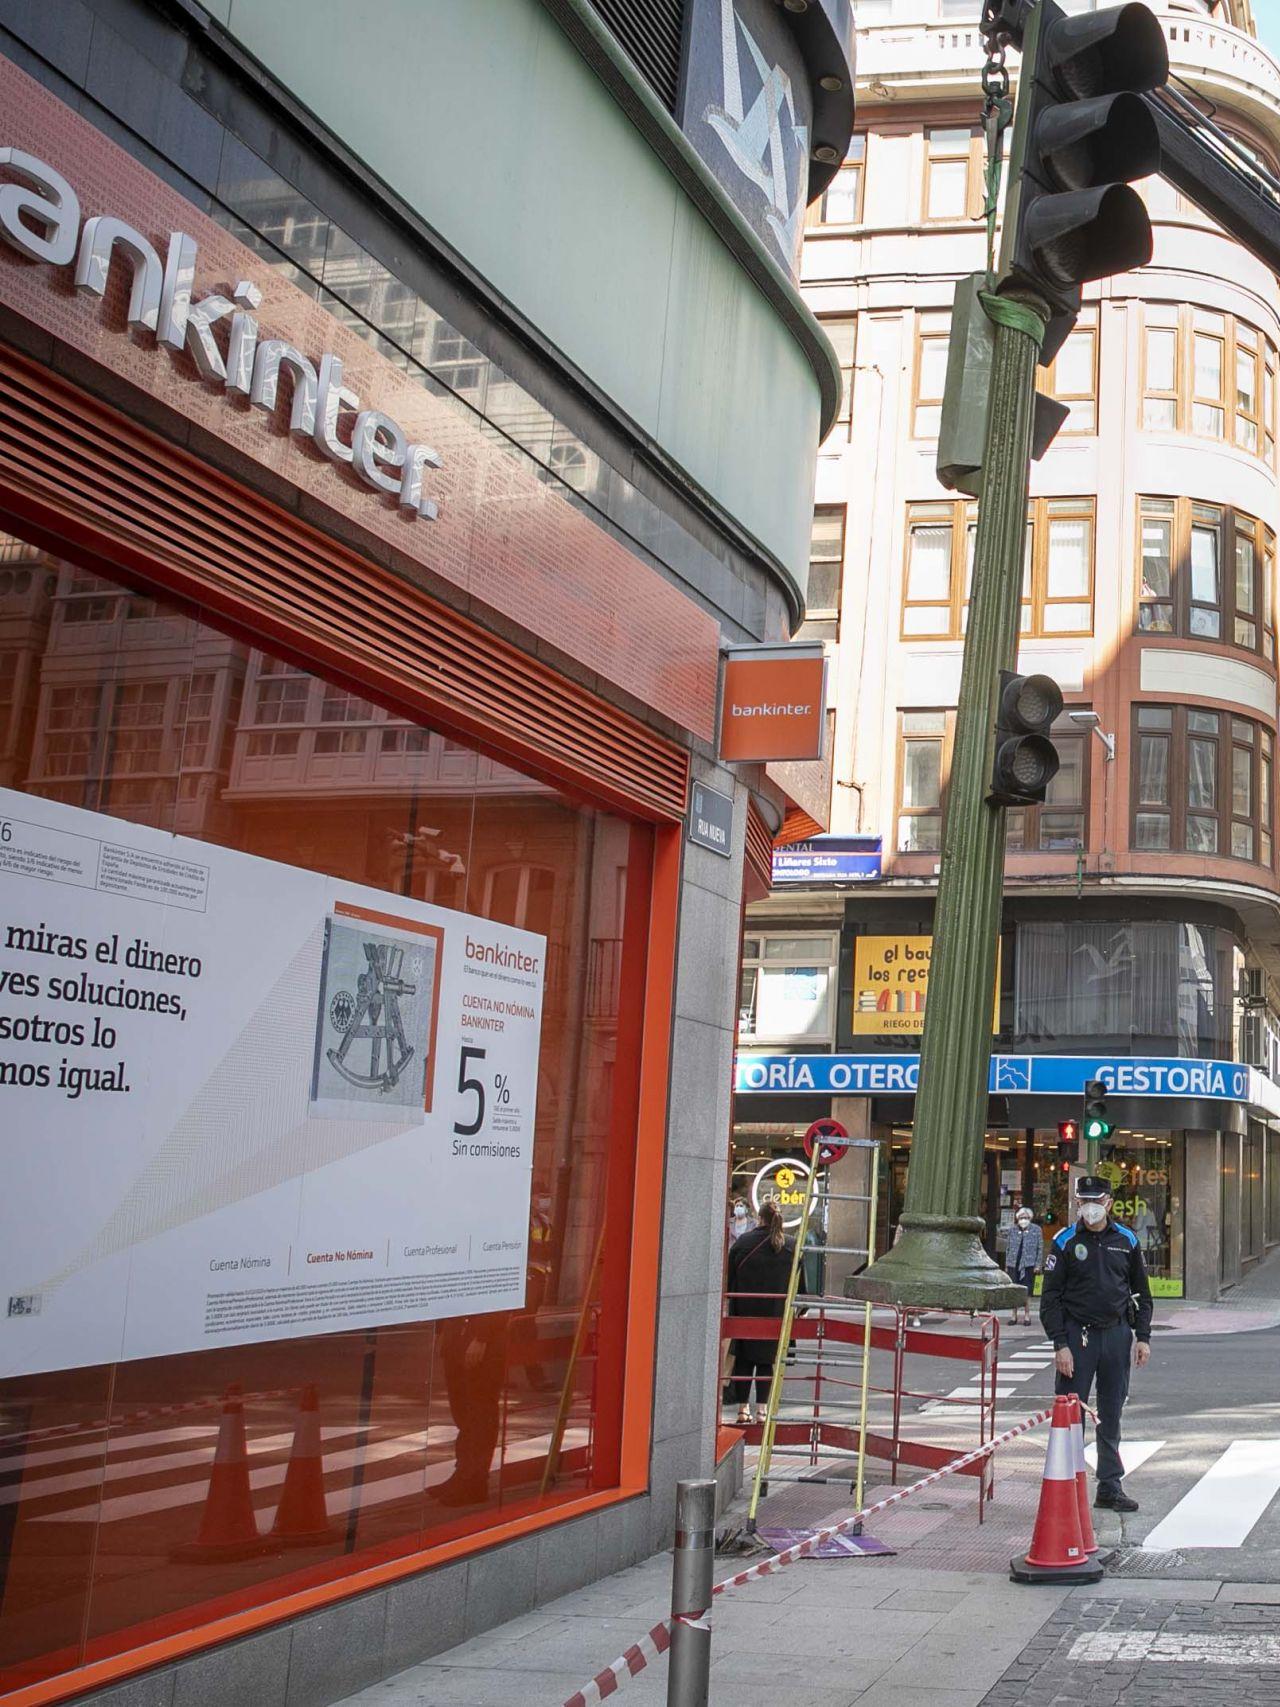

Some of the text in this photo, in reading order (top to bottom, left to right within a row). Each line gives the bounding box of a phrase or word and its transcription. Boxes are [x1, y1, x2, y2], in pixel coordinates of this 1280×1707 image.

[813, 856, 838, 867] Sixto
[5, 923, 201, 978] miras el dinero
[465, 936, 539, 974] bankinter.
[884, 944, 898, 964] el
[868, 965, 890, 982] los
[47, 972, 187, 1021] soluciones,
[462, 994, 535, 1020] CUENTA NO NÓMINA
[91, 1017, 116, 1049] lo
[461, 1014, 505, 1033] BANKINTER
[883, 1019, 911, 1028] RIEGO
[57, 1058, 130, 1099] igual.
[454, 1046, 510, 1136] 5 %
[452, 1140, 520, 1158] Sin comisiones
[306, 1248, 373, 1264] Cuenta No Nómina
[404, 1244, 458, 1257] Cuenta Profesional
[482, 1242, 501, 1252] Cuenta
[210, 1256, 271, 1272] Cuenta Nómina
